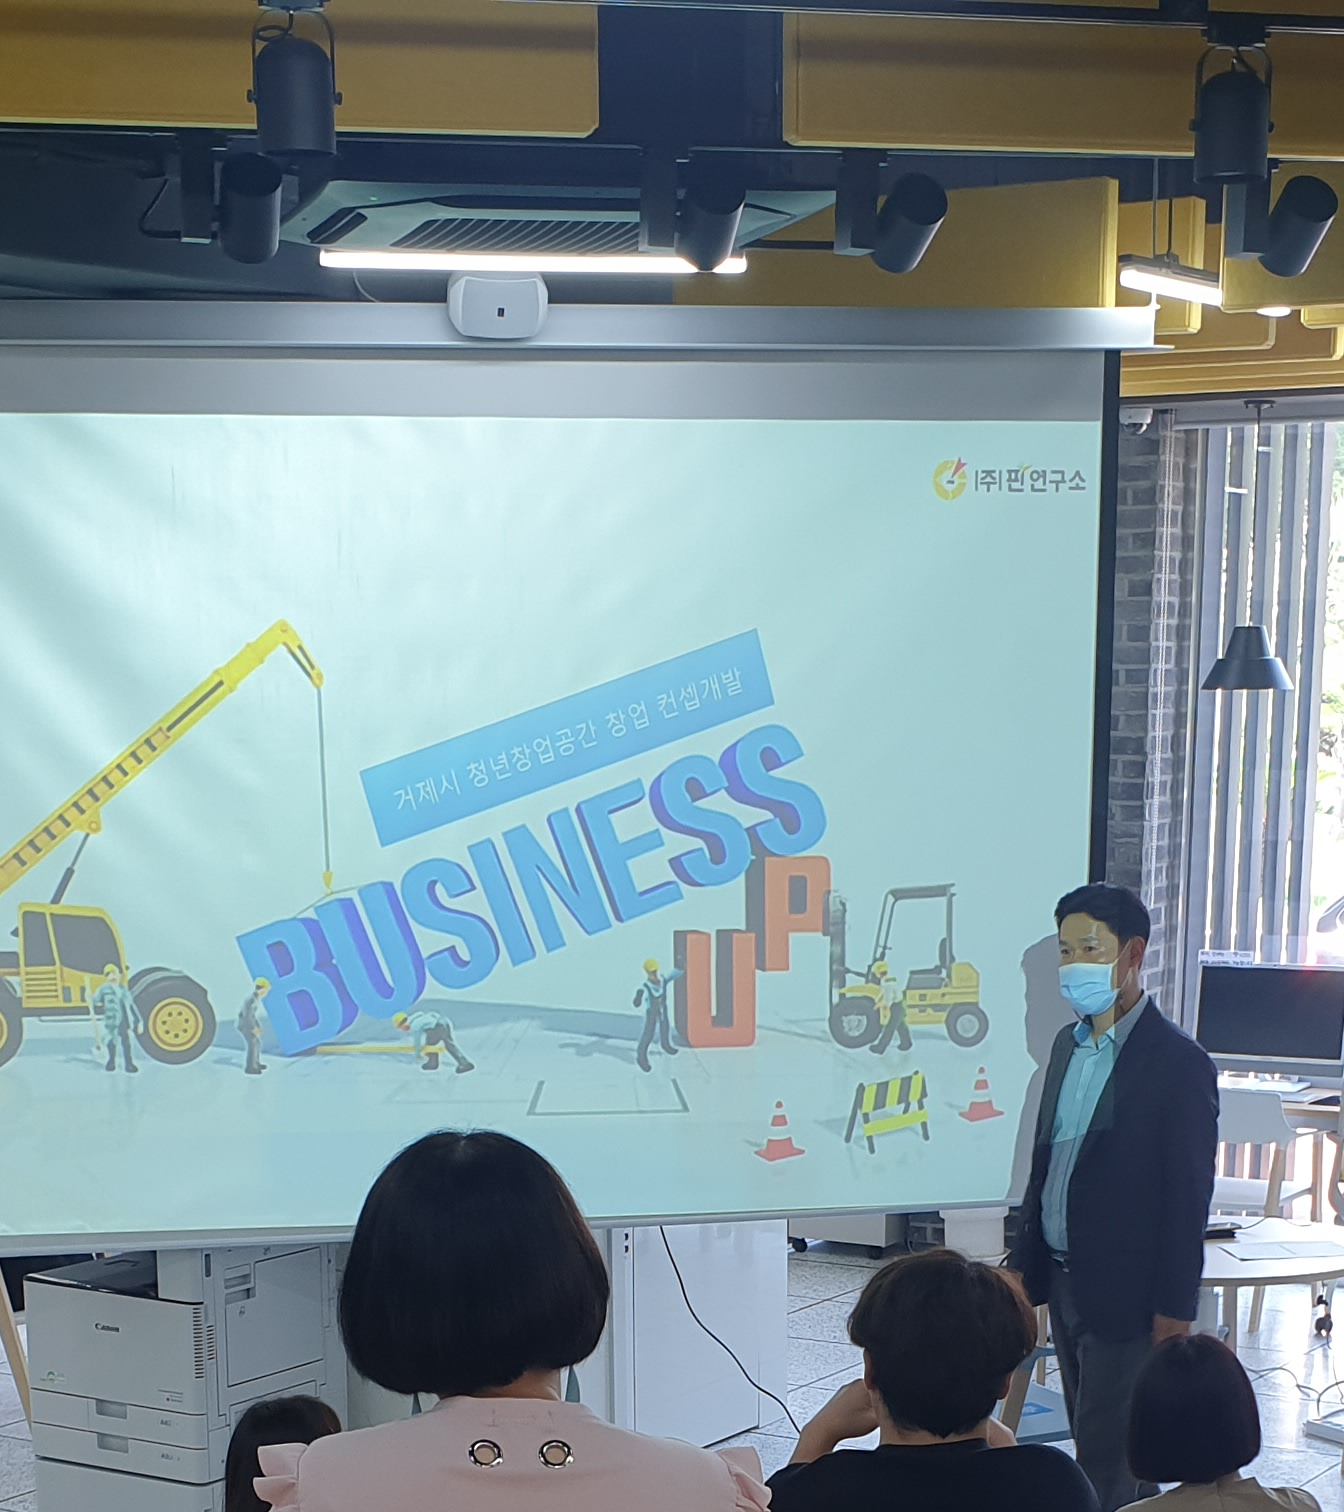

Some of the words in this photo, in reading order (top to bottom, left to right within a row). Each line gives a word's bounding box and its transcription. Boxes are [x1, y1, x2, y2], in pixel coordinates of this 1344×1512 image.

[392, 769, 462, 812] 거제시
[466, 719, 599, 788] 청년창업공간
[604, 701, 649, 738] 창업
[656, 666, 744, 720] 컨셉개발
[236, 723, 827, 1056] BUSINESS
[674, 854, 831, 1048] UP
